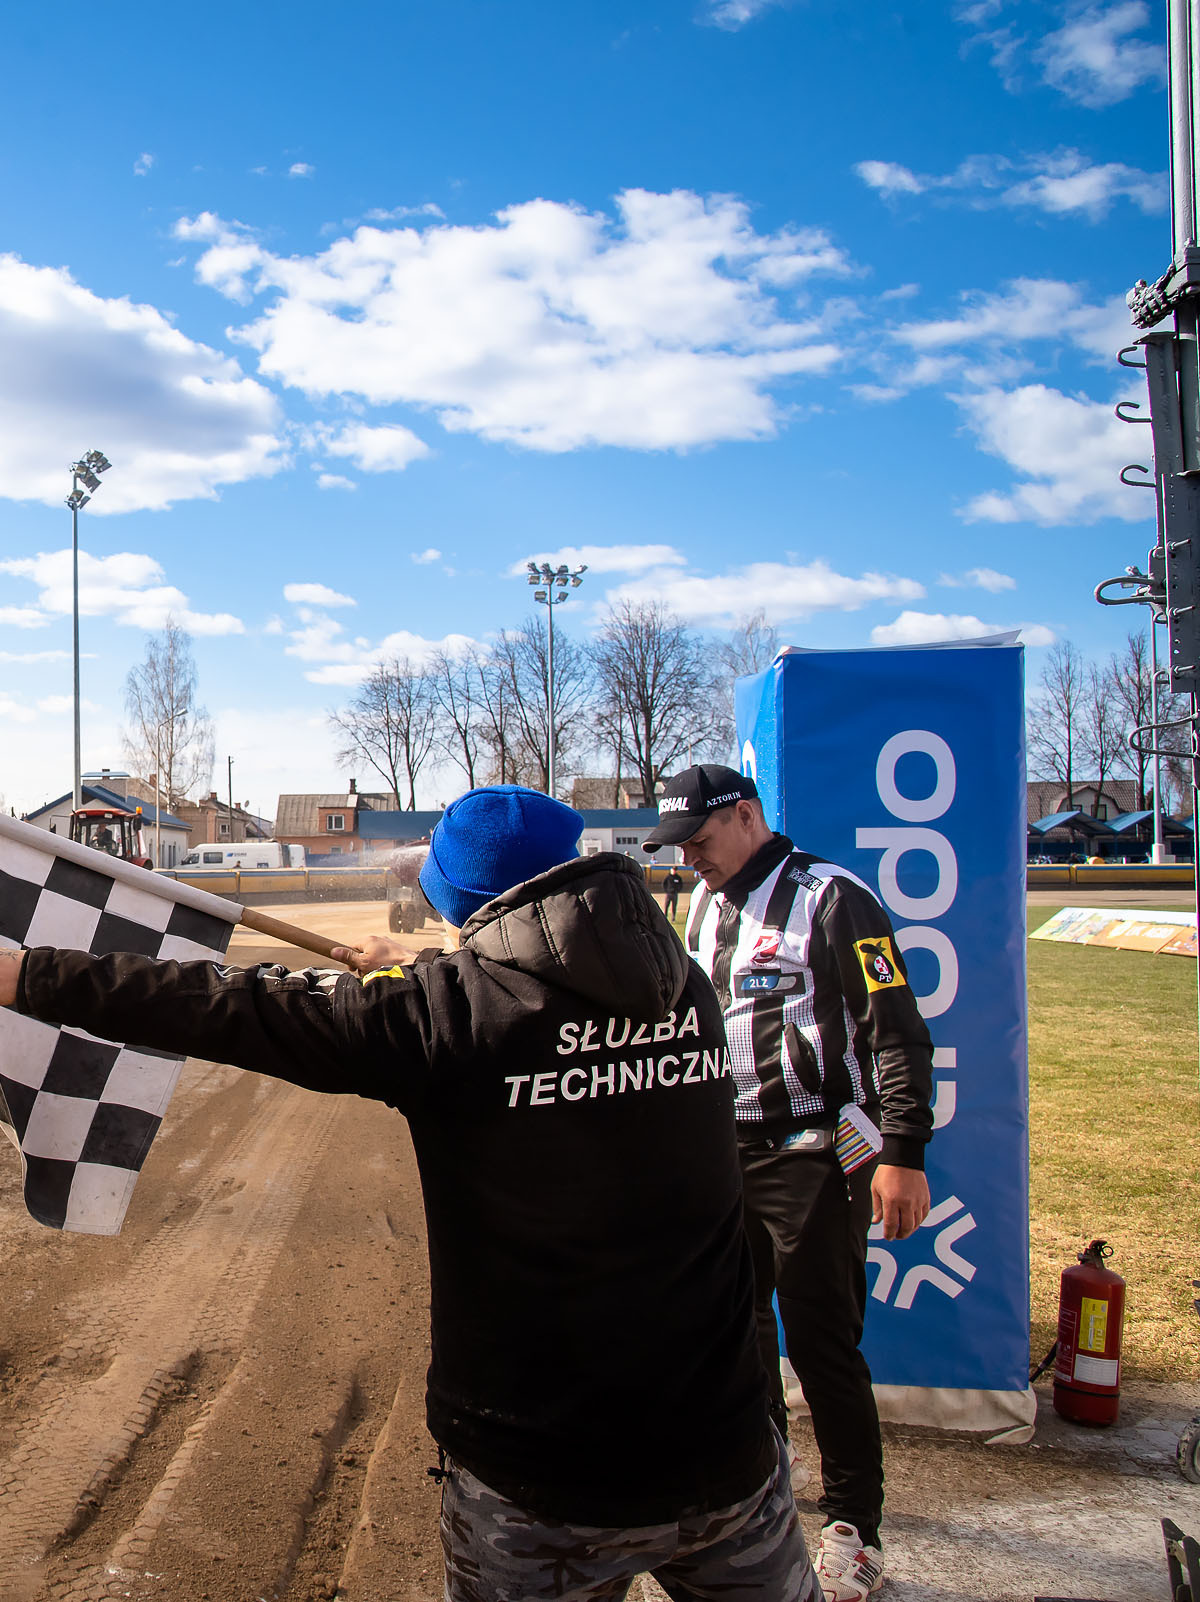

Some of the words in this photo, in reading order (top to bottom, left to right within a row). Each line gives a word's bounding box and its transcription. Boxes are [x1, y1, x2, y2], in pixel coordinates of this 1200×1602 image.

[706, 791, 742, 808] AZTORIN
[856, 729, 959, 1130] odo
[504, 1046, 733, 1108] TECHNICZNA
